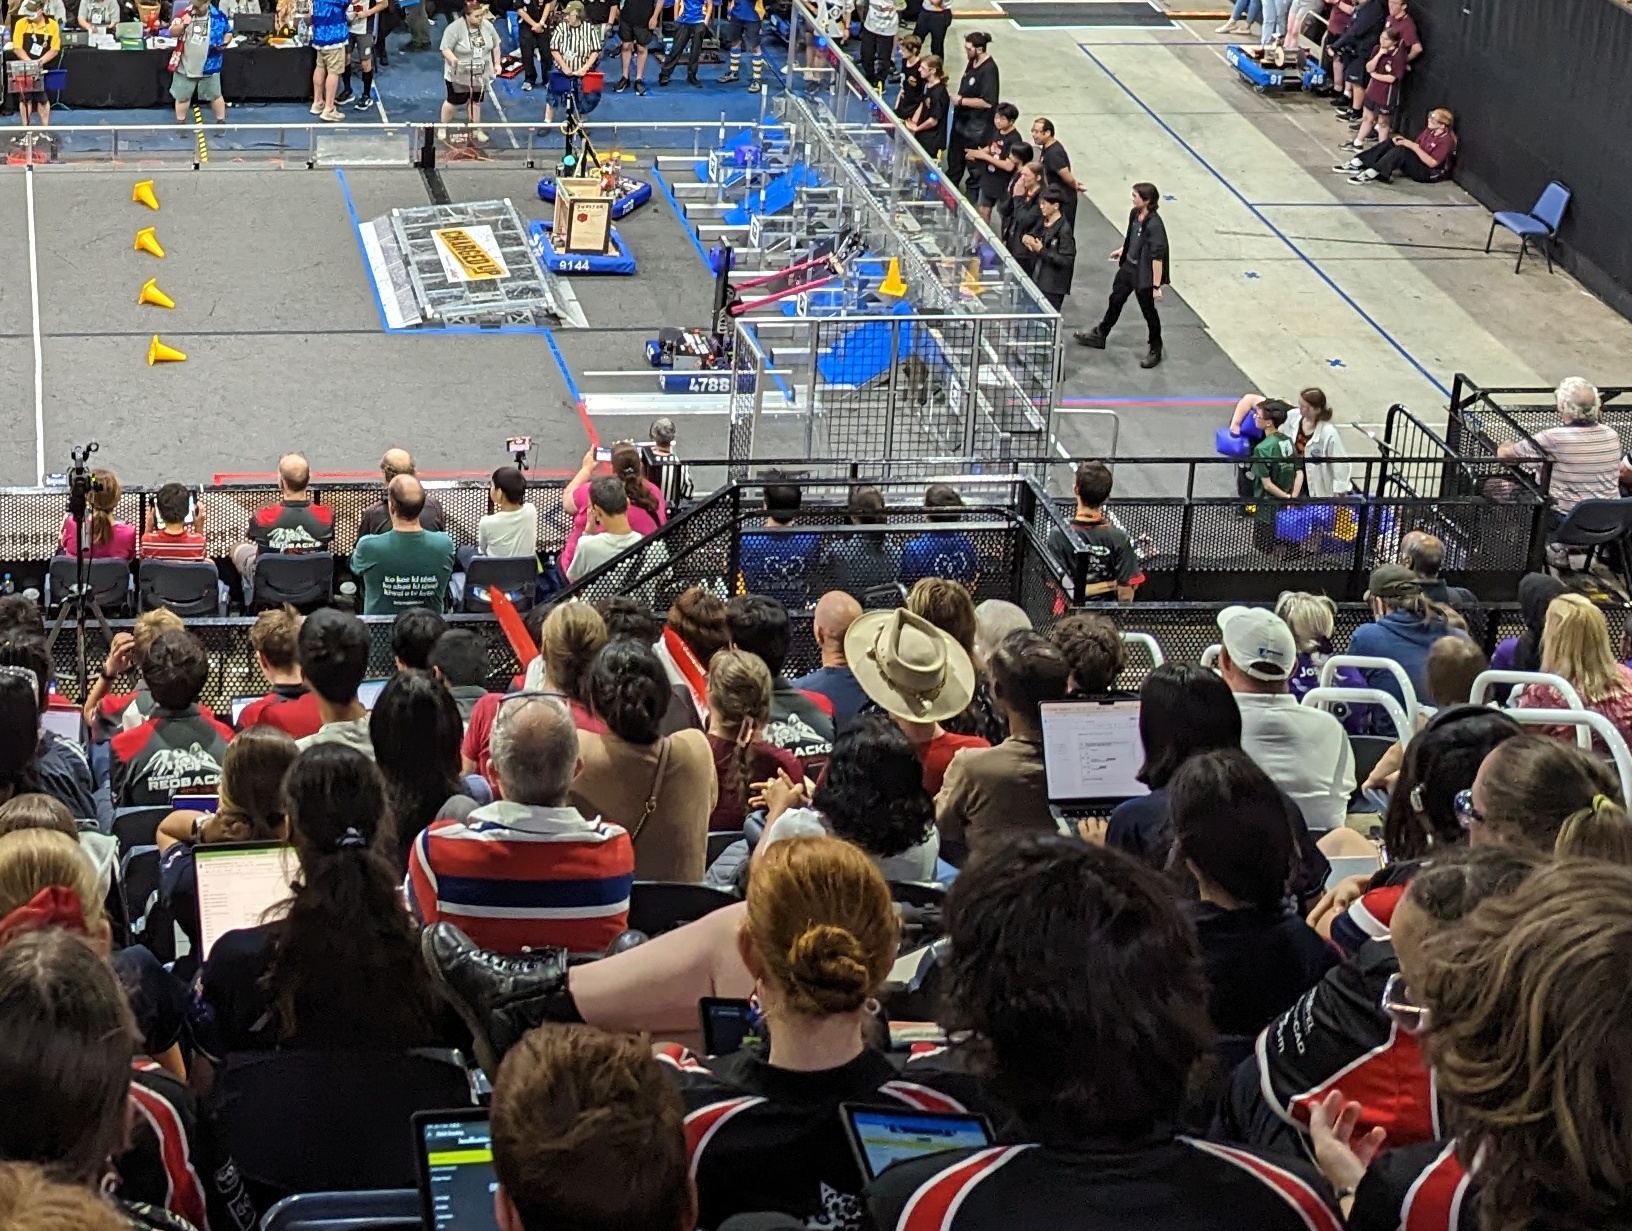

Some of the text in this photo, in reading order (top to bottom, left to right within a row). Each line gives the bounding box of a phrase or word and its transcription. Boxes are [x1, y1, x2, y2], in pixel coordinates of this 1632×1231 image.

[559, 259, 590, 271] 9144
[689, 377, 730, 392] 4788
[793, 743, 834, 757] ACKS
[148, 774, 222, 792] REDBACK
